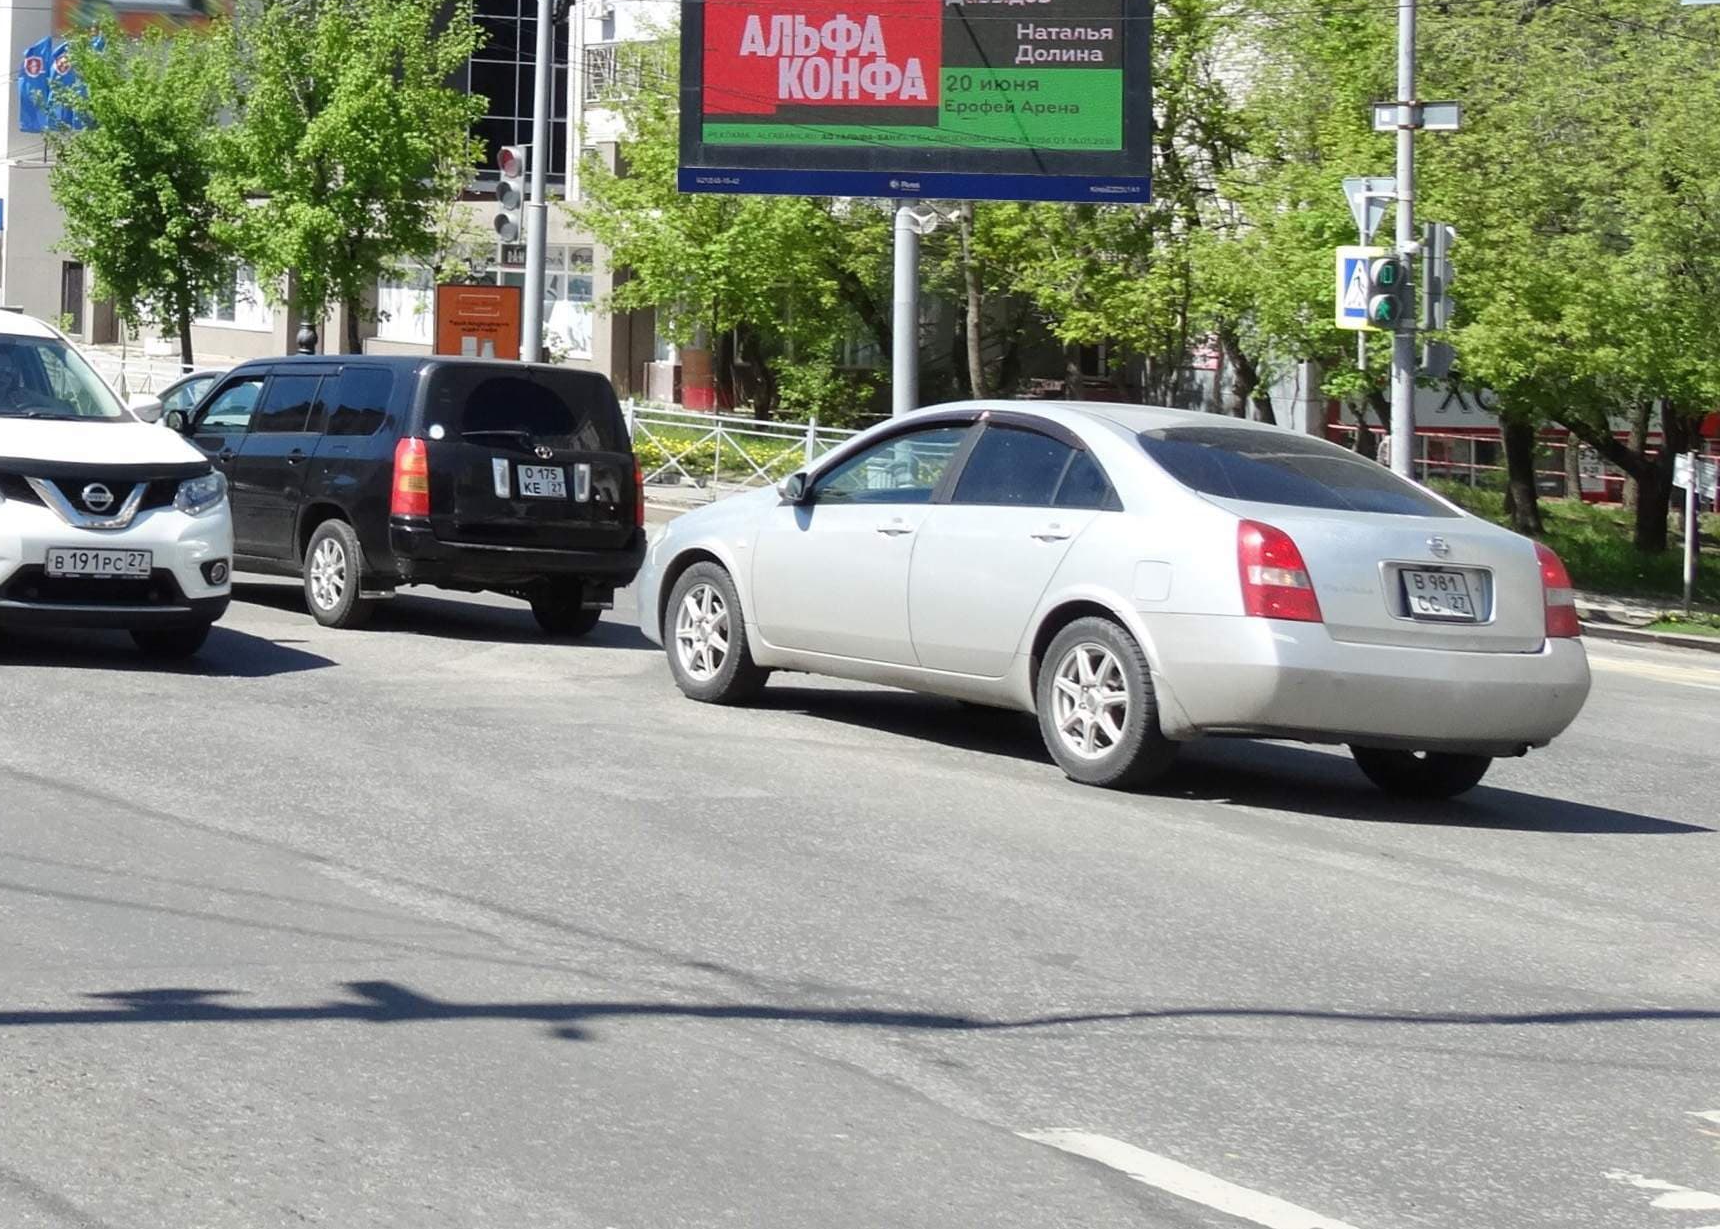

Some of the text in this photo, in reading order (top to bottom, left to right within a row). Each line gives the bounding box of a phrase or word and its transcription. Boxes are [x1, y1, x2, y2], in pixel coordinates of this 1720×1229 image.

[739, 14, 887, 57] АЛЬФА
[1016, 23, 1114, 41] Наталья
[1015, 44, 1104, 65] Долина
[778, 57, 928, 101] КОНФА
[945, 74, 1040, 92] 20 июня
[944, 99, 1080, 117] Ерофей Арена
[1429, 574, 1458, 592] 981
